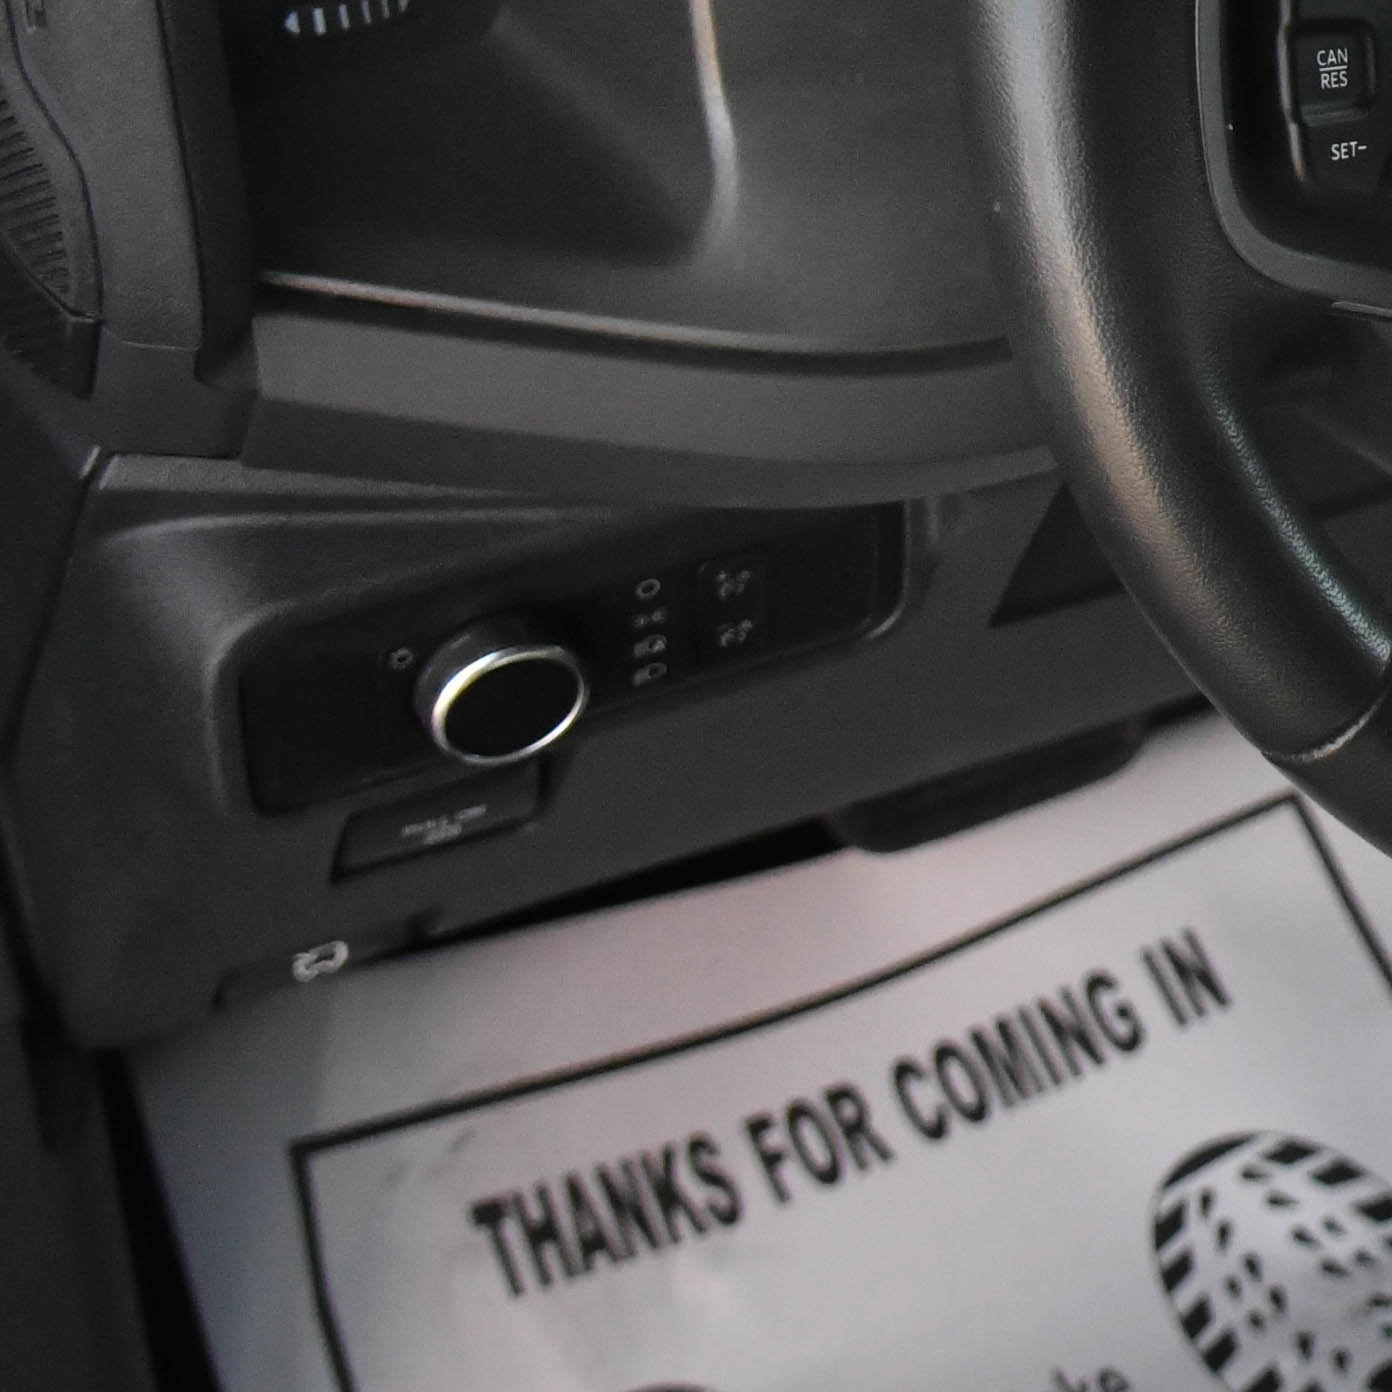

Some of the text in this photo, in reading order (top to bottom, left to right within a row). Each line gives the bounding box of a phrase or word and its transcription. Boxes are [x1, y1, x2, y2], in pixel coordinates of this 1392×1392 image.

[1316, 47, 1349, 67] CAN
[1320, 70, 1348, 90] RES
[468, 925, 1235, 1300] THANKS FOR COMING IN
